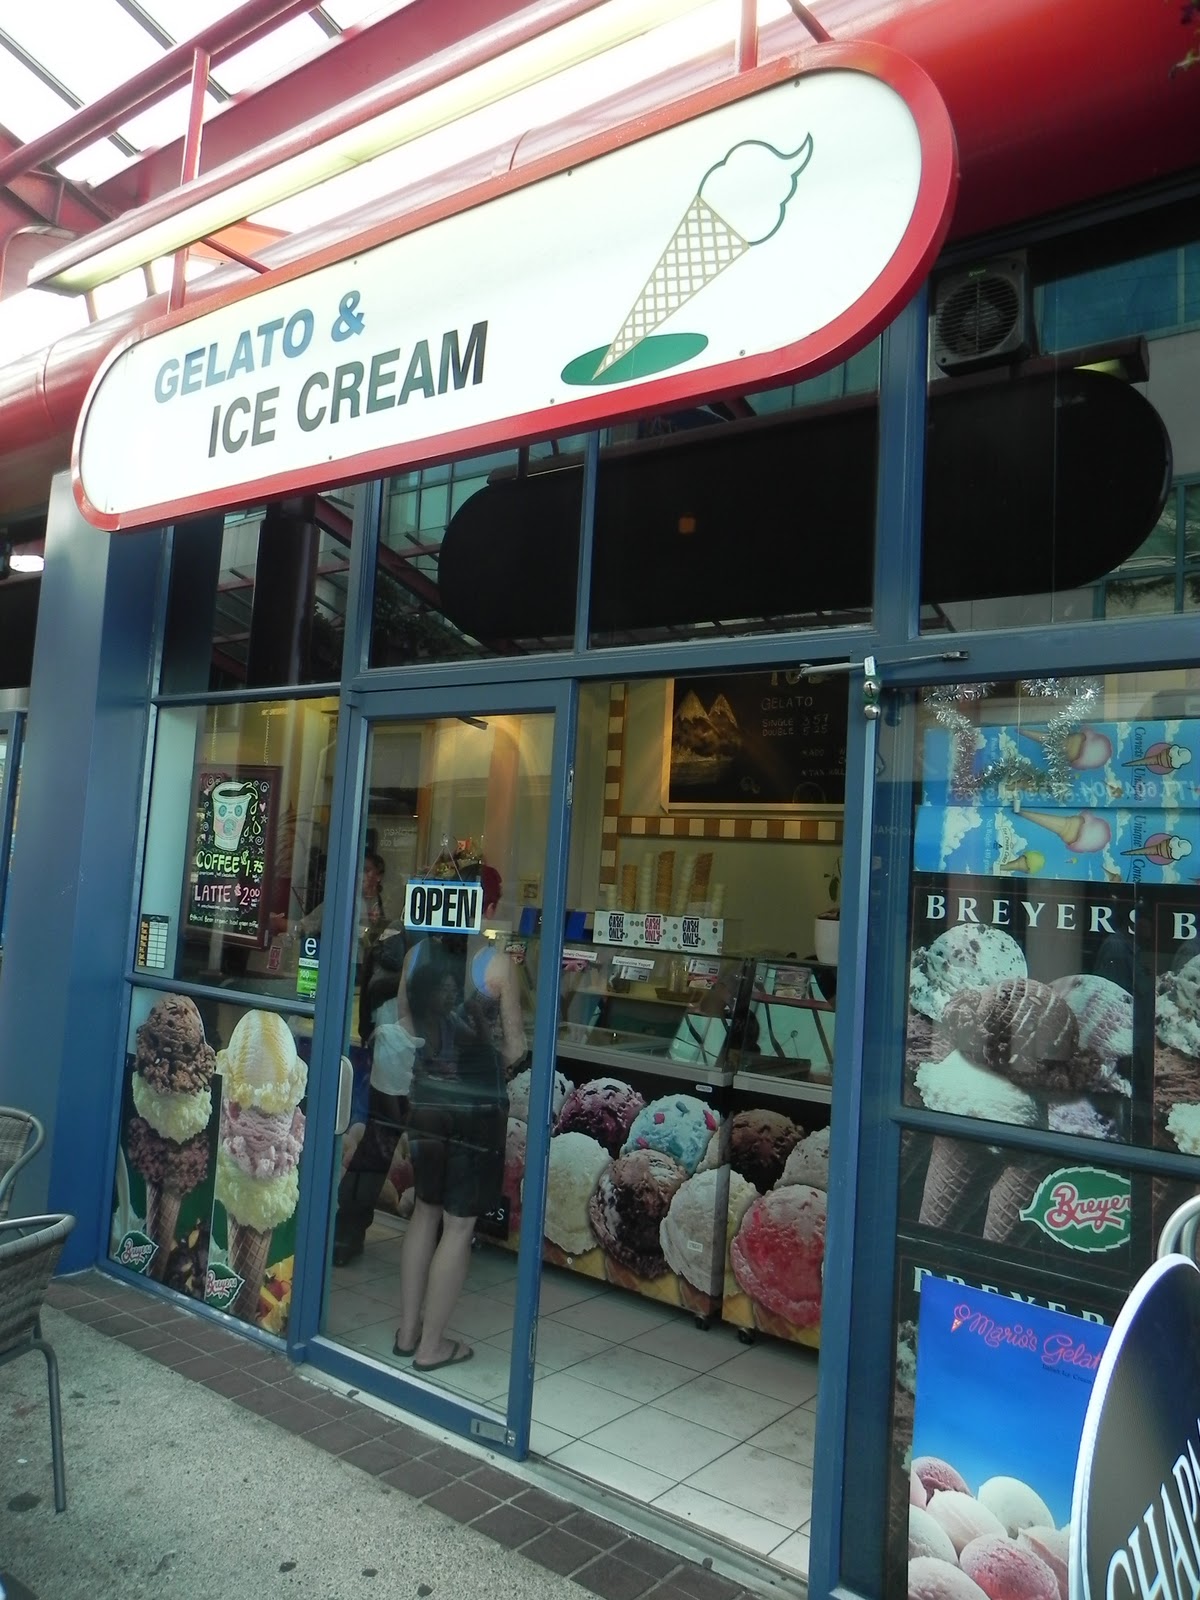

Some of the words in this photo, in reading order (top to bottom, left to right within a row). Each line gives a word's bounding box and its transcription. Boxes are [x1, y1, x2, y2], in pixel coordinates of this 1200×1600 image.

[155, 308, 315, 403] GELATO
[331, 290, 366, 343] &
[208, 386, 281, 458] ICE
[297, 320, 489, 432] CREAM
[761, 696, 814, 711] GELATO
[762, 719, 794, 728] SINGLE
[762, 728, 795, 737] DOUBLE
[1134, 726, 1146, 758] Cornets
[1132, 815, 1147, 847] Unique
[196, 850, 240, 873] COFFEE
[194, 884, 232, 902] LATTE
[409, 886, 478, 928] OPEN
[608, 915, 624, 928] CASH
[644, 918, 661, 930] CASH
[682, 920, 699, 933] CASH
[608, 928, 625, 939] ONLY
[644, 930, 662, 942] ONLY
[682, 932, 701, 945] ONLY
[968, 1311, 1038, 1352] Mario's
